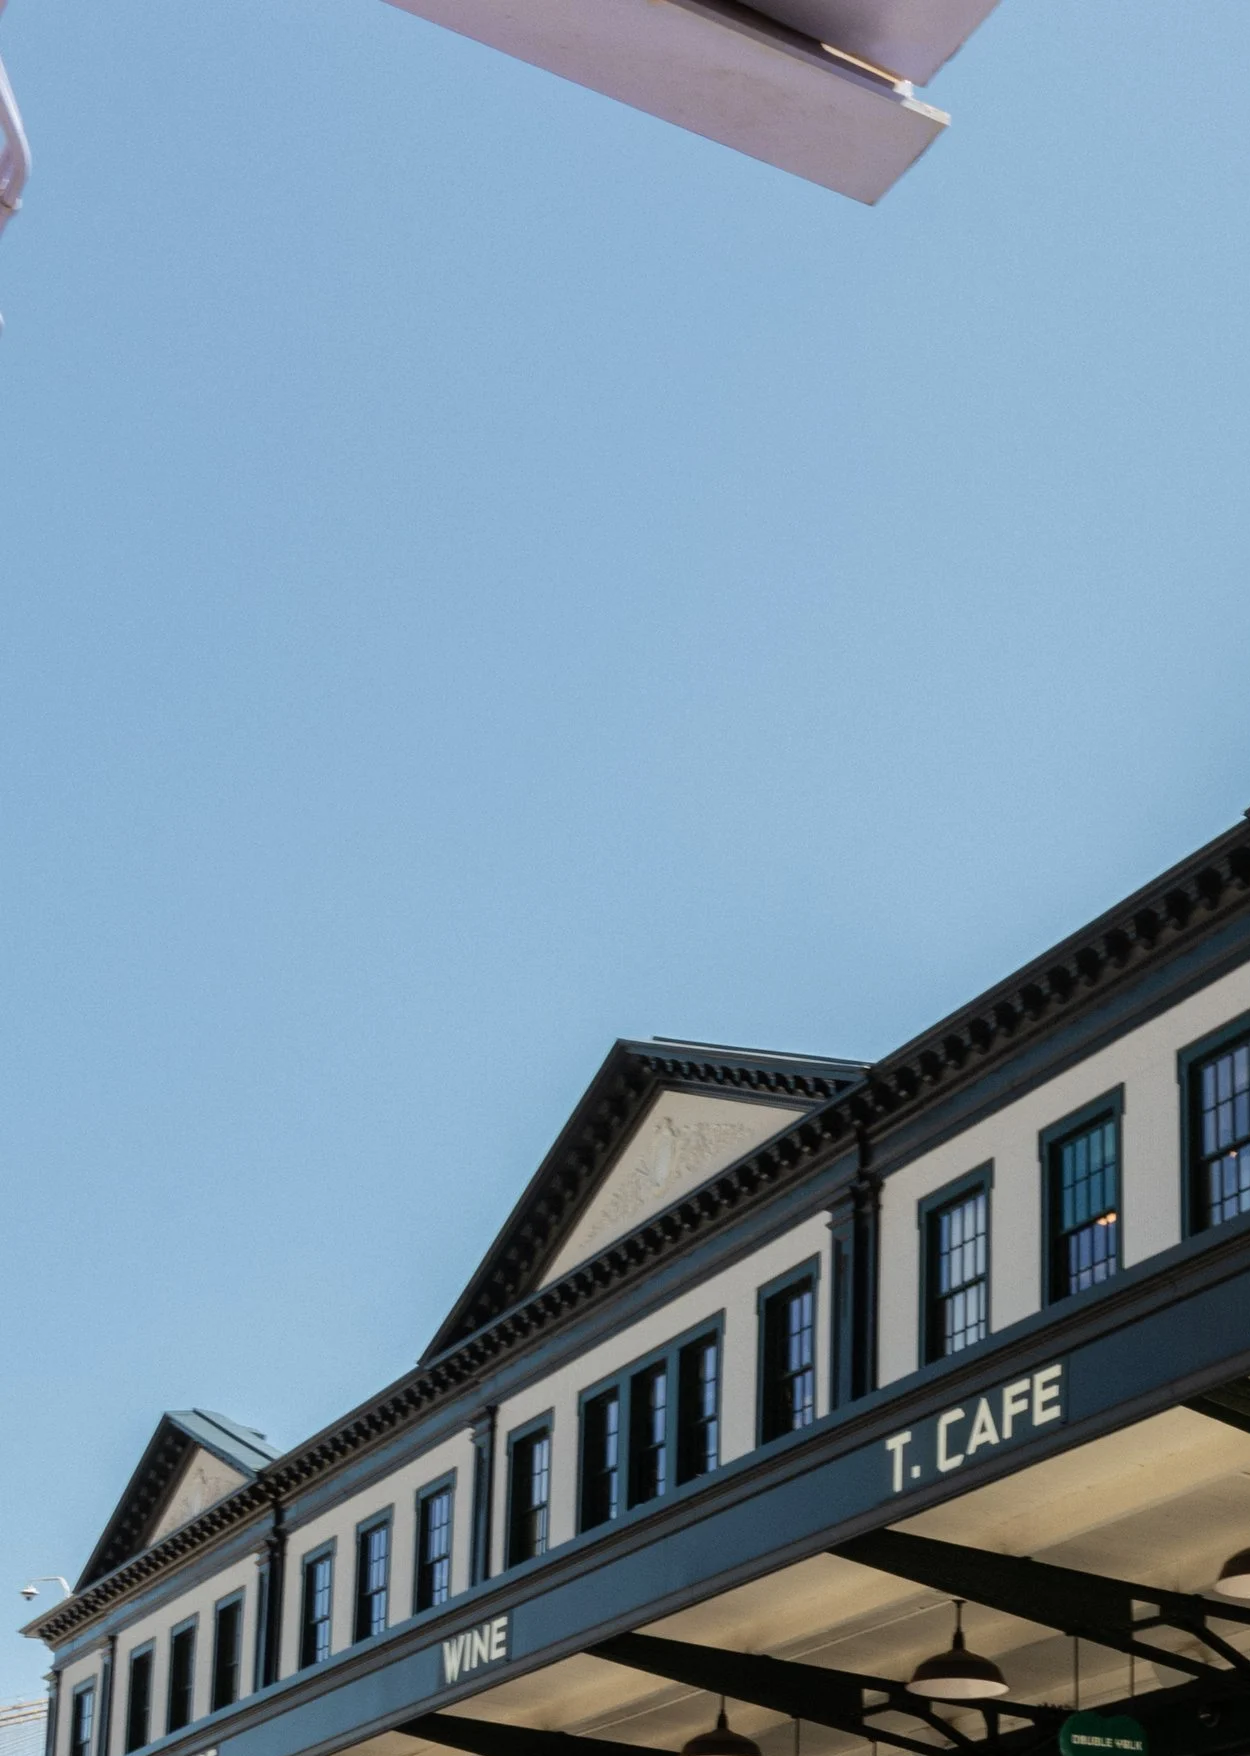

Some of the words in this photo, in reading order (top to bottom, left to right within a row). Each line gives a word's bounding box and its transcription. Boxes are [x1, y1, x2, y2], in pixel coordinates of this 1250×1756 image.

[885, 1430, 921, 1493] T.
[936, 1363, 1063, 1473] CAFE
[442, 1615, 509, 1685] WINE
[1071, 1733, 1113, 1748] DOUBLE
